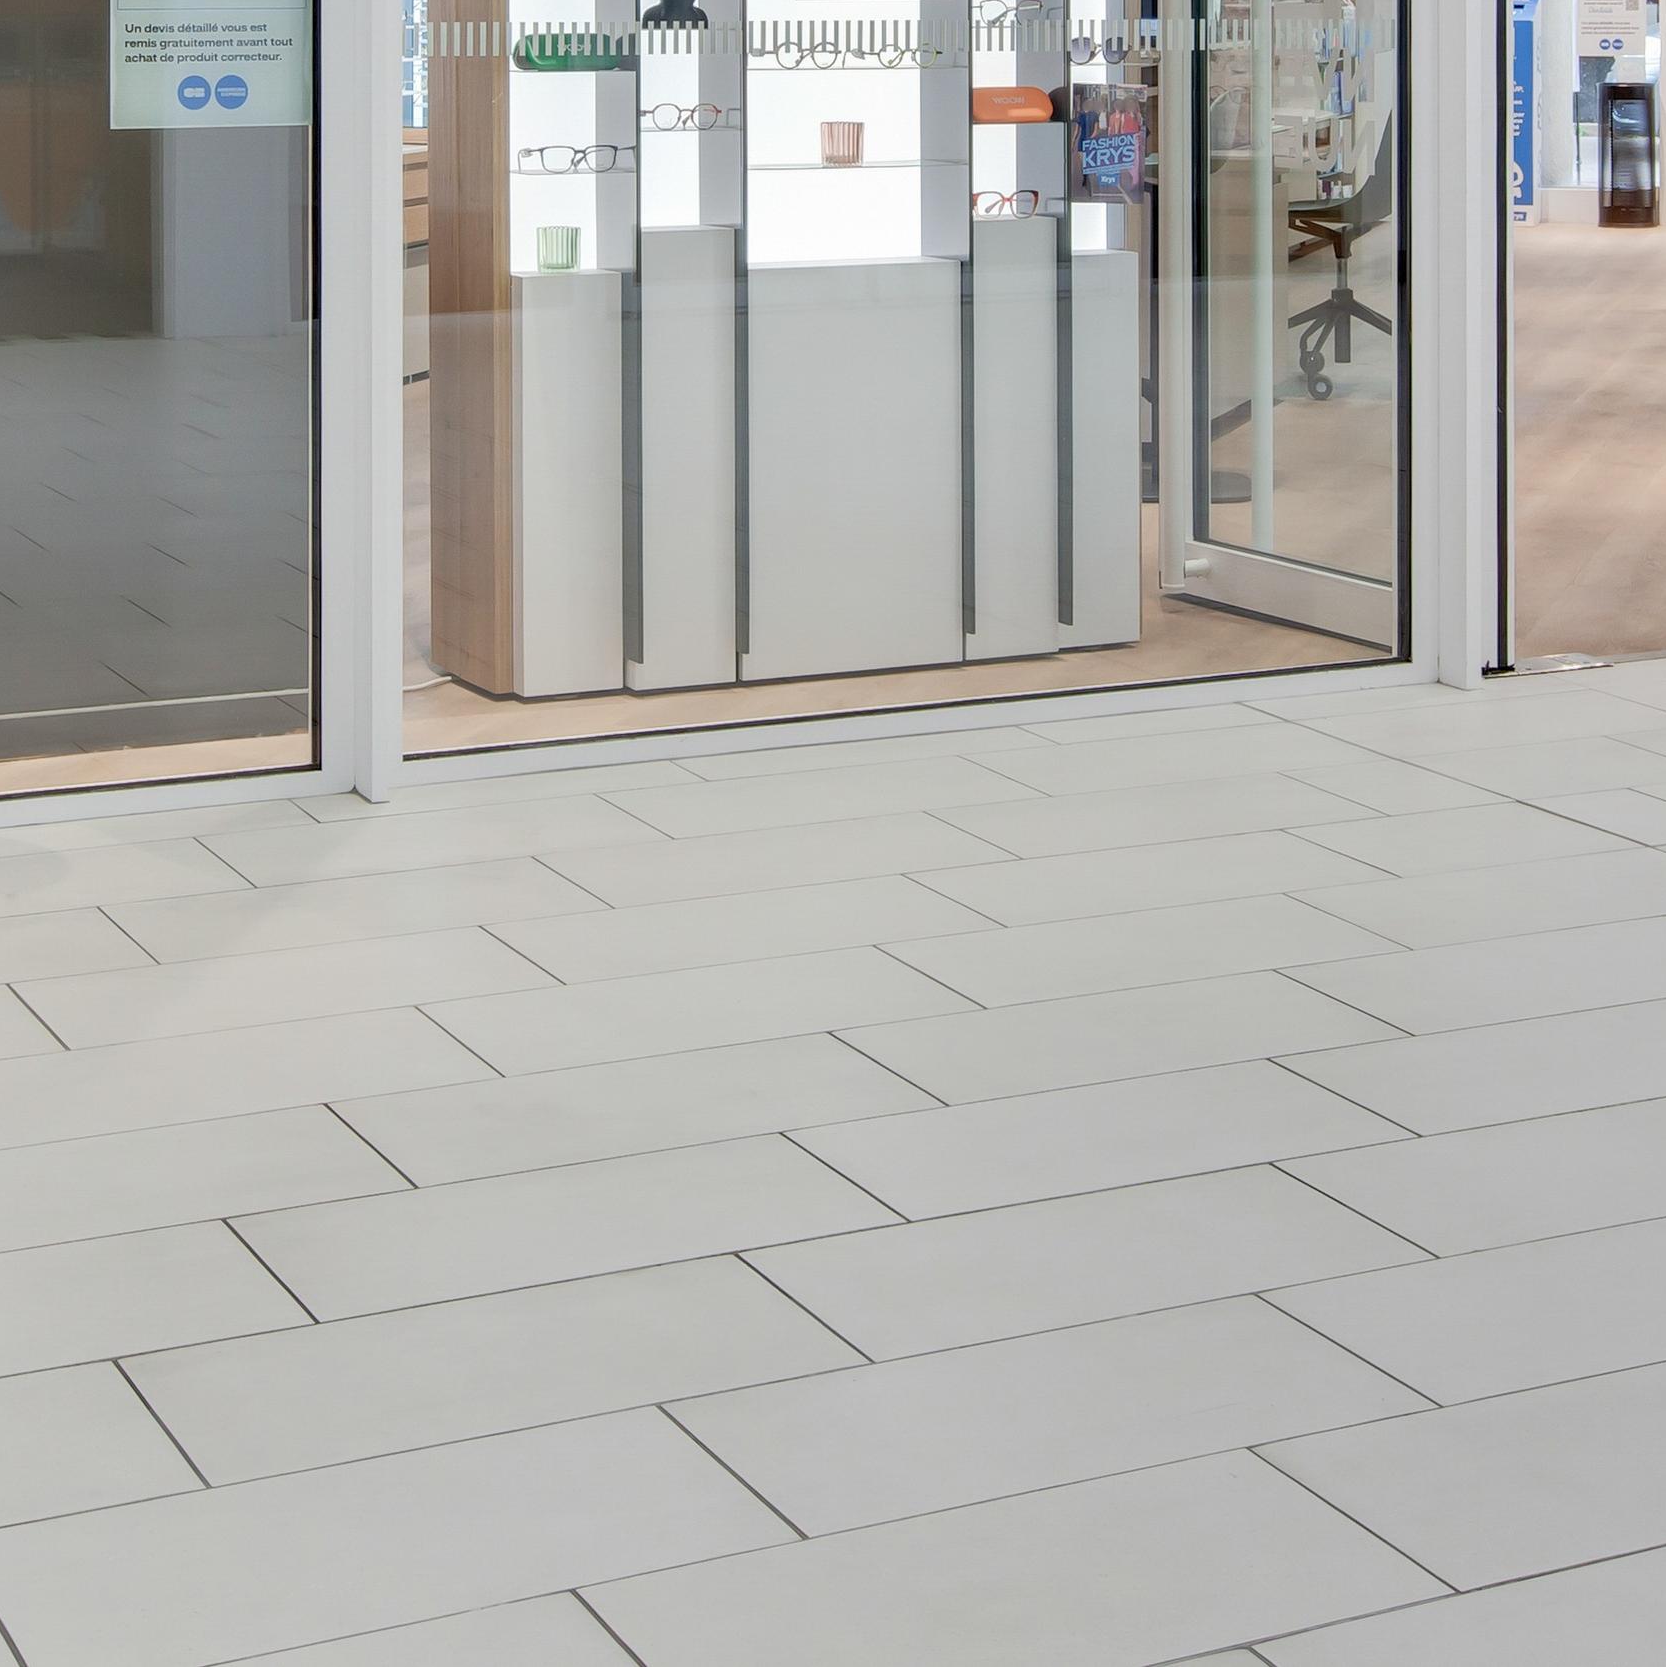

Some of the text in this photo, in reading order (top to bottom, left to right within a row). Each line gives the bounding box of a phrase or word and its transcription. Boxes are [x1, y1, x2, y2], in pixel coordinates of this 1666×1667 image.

[125, 22, 267, 34] Un devis détaillé vous est
[125, 37, 293, 50] remis gratuitement avant tout
[125, 52, 158, 63] achat
[160, 52, 174, 63] de
[177, 52, 219, 64] produit
[1082, 134, 1136, 152] FASHION
[1082, 147, 1136, 168] KRYS
